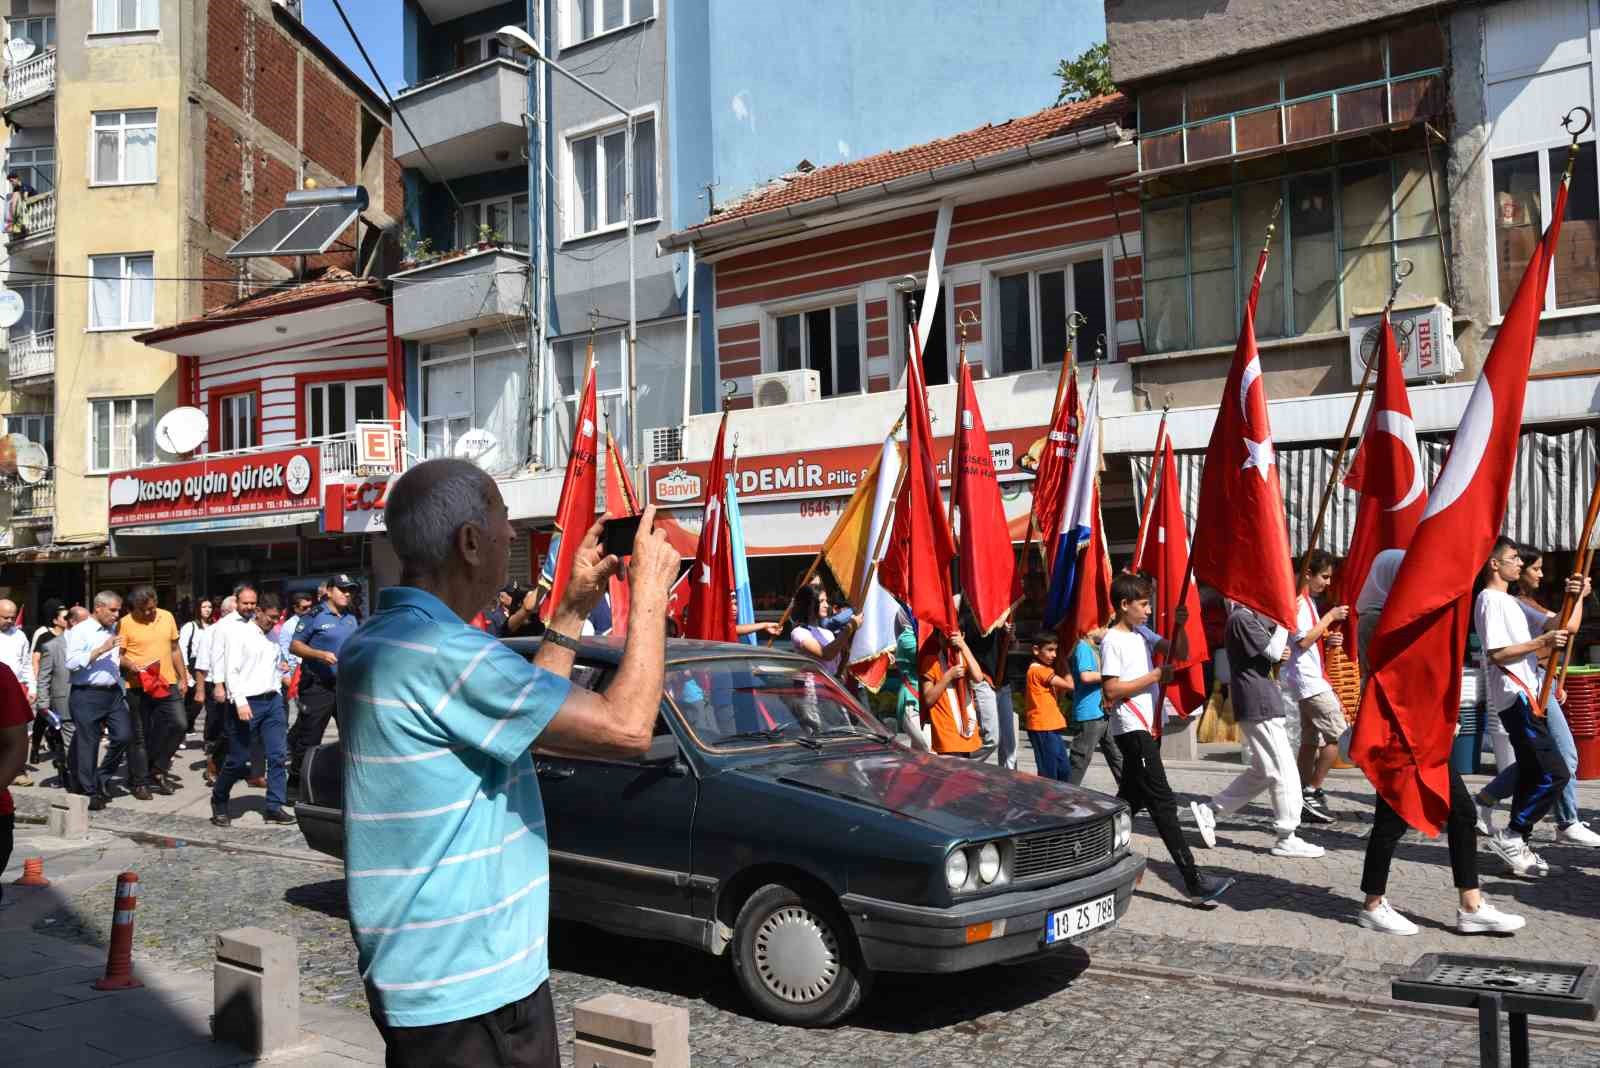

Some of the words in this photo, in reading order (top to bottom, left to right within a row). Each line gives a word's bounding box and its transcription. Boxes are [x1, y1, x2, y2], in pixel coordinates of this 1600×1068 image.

[1419, 319, 1432, 369] VESTEL
[367, 434, 386, 458] E
[138, 478, 181, 502] kasap
[184, 471, 228, 500] aydın
[231, 463, 284, 497] gürlek
[658, 481, 698, 497] Banvit
[827, 469, 857, 486] Piliç
[1056, 913, 1069, 936] 10
[1077, 906, 1090, 930] ZS
[1096, 897, 1113, 924] 788
